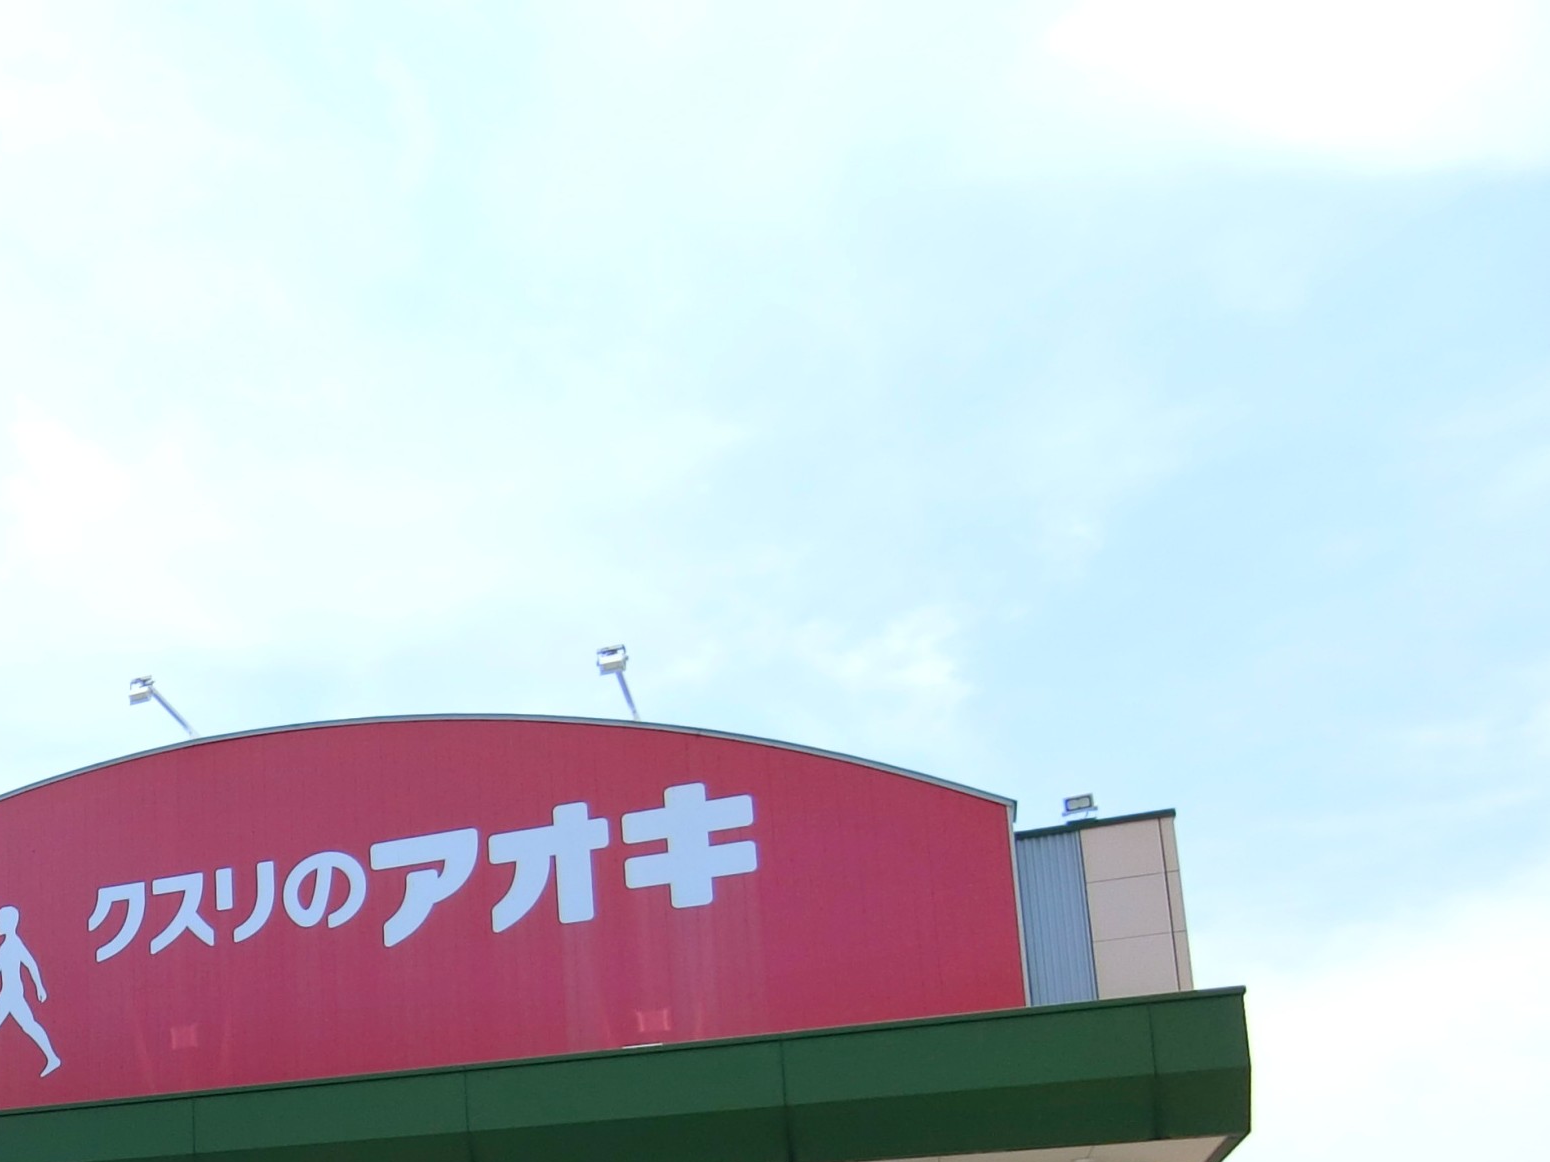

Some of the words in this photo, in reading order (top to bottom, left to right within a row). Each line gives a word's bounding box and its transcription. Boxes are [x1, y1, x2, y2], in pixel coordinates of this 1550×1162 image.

[88, 782, 758, 962] クスリのアオキ
